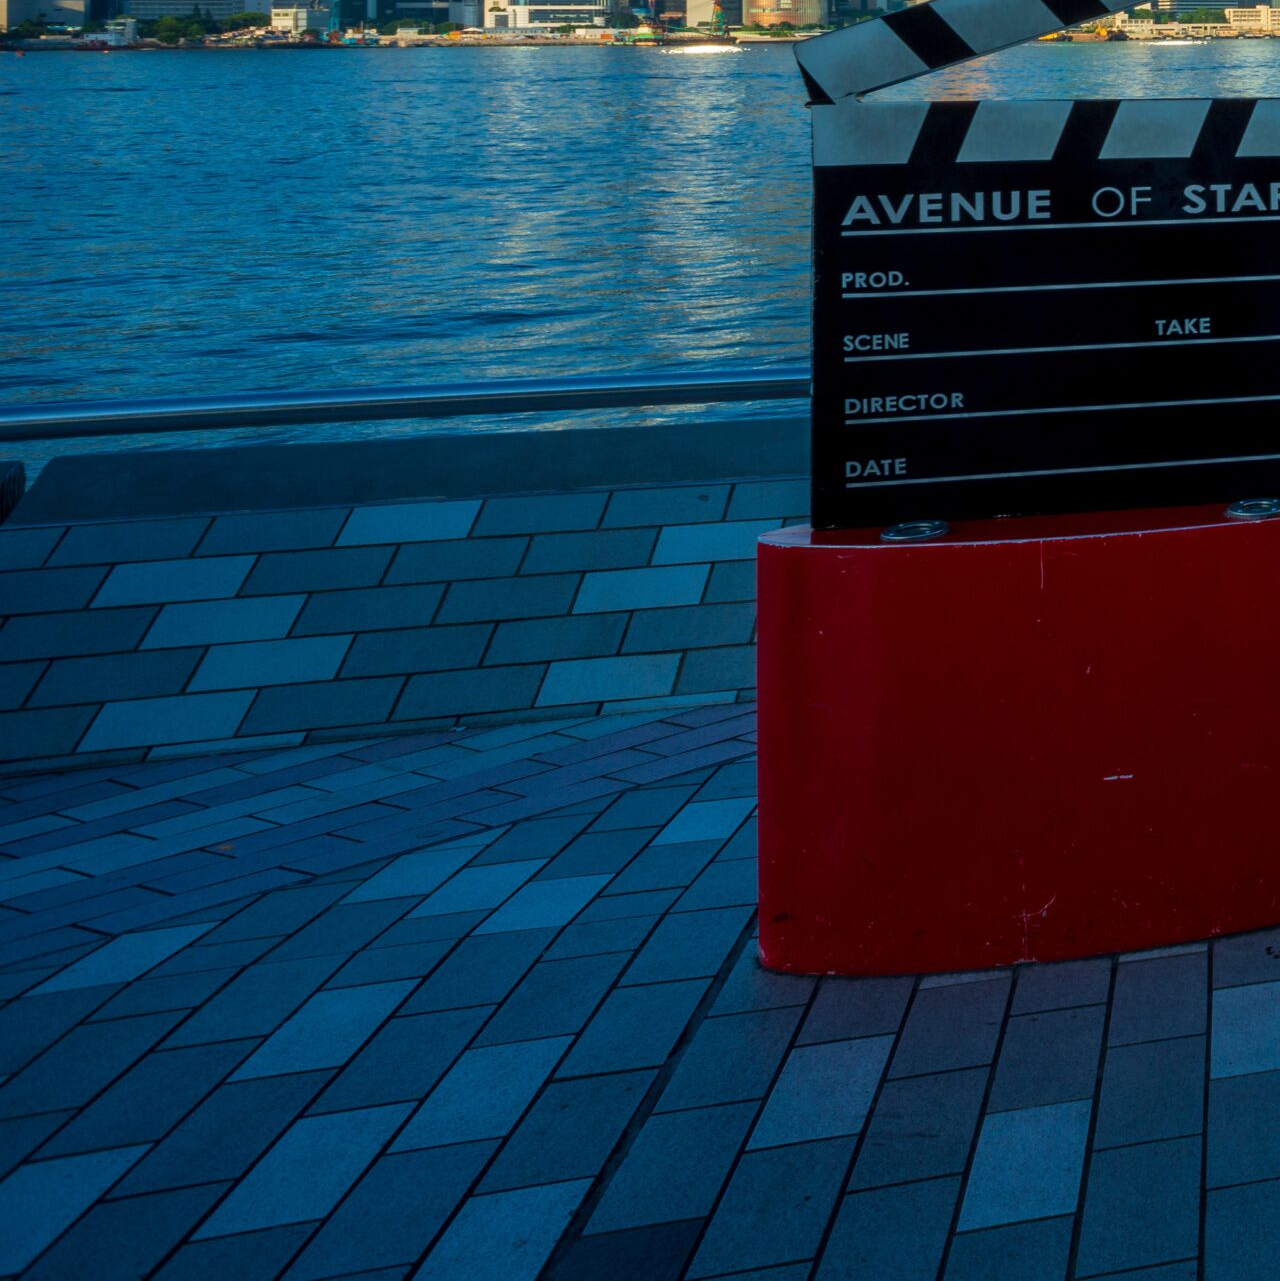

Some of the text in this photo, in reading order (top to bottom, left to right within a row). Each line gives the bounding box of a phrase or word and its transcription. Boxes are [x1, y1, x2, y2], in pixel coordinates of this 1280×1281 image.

[842, 189, 1051, 226] AVENUE
[1091, 186, 1152, 218] OF
[841, 271, 910, 289] PROD.
[1155, 317, 1211, 336] TAKE
[843, 332, 910, 352] SCENE
[844, 392, 965, 415] DIRECTOR
[845, 458, 907, 478] DATE
